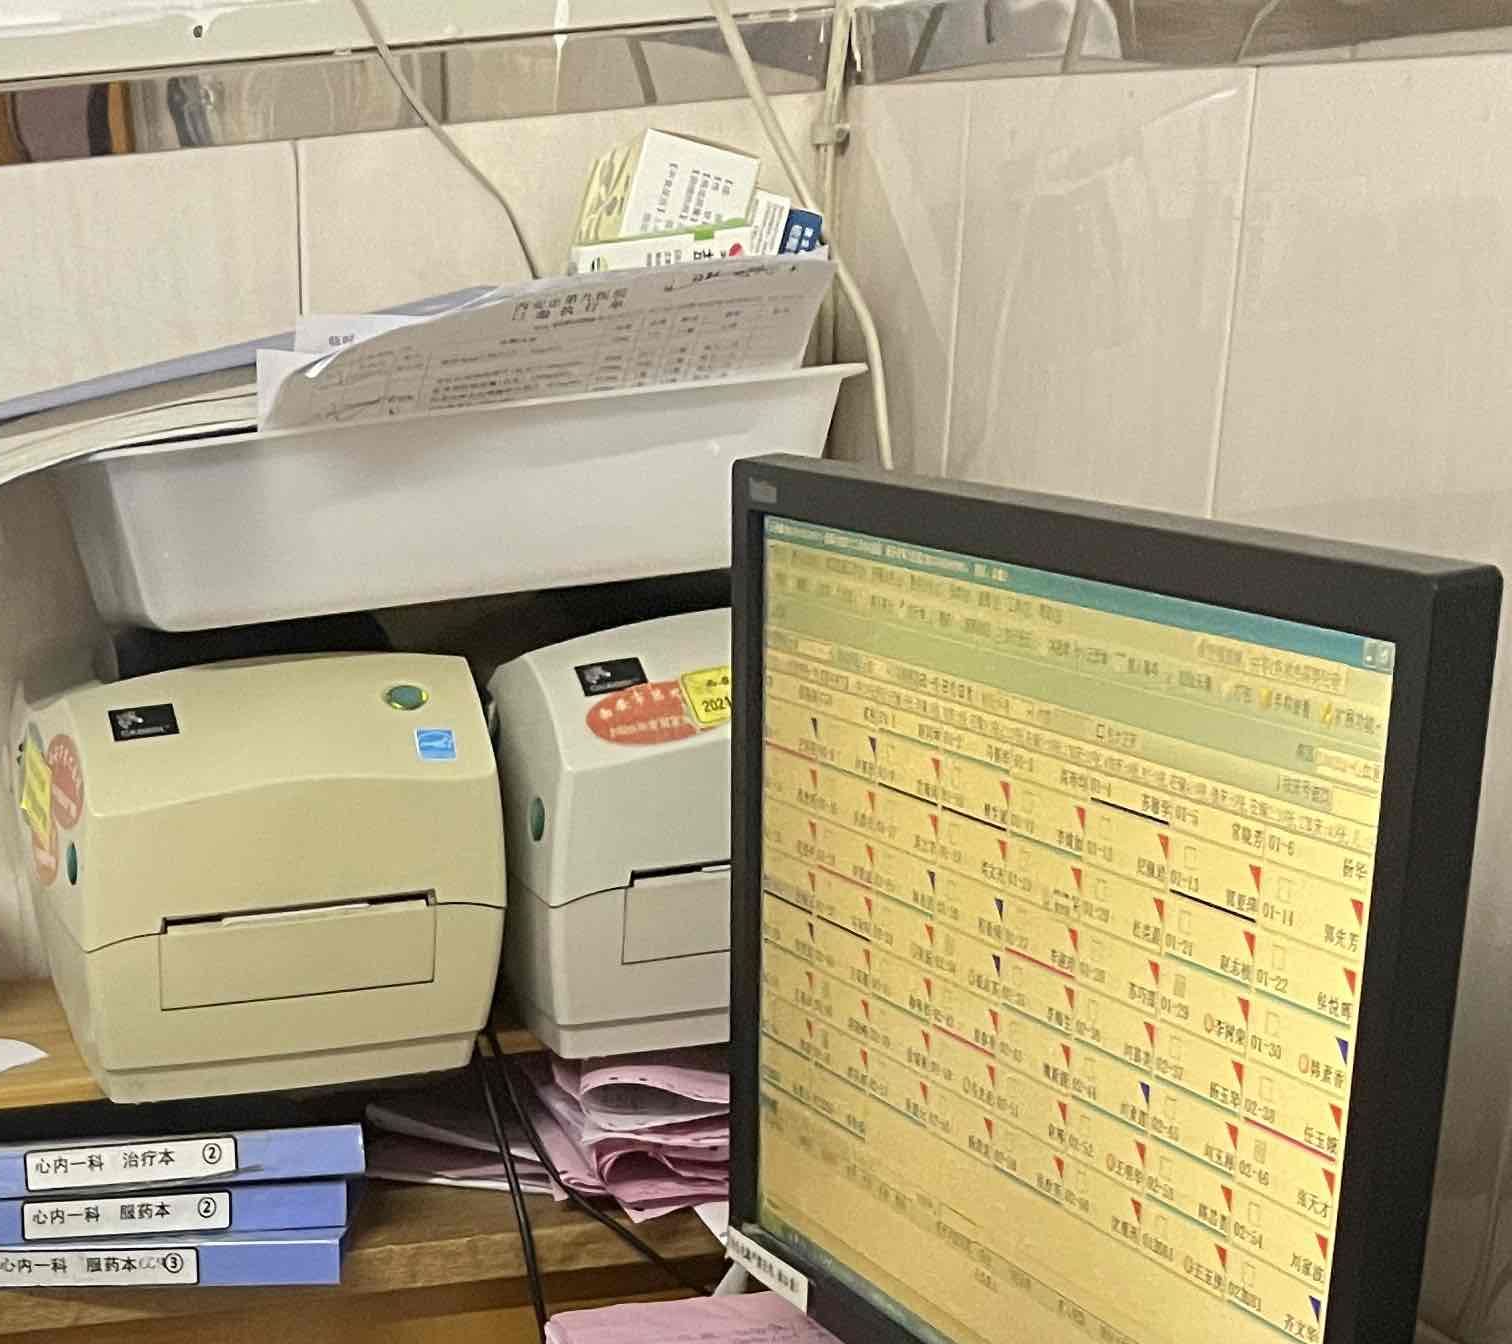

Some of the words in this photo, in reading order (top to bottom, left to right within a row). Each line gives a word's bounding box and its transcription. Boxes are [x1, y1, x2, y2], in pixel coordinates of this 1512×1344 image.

[35, 1152, 105, 1175] 心内一科
[122, 1147, 176, 1170] 治疗本
[32, 1205, 101, 1226] 心内一科
[119, 1201, 172, 1221] 服药本
[0, 1256, 68, 1274] 心内一科
[85, 1256, 139, 1274] 服药本
